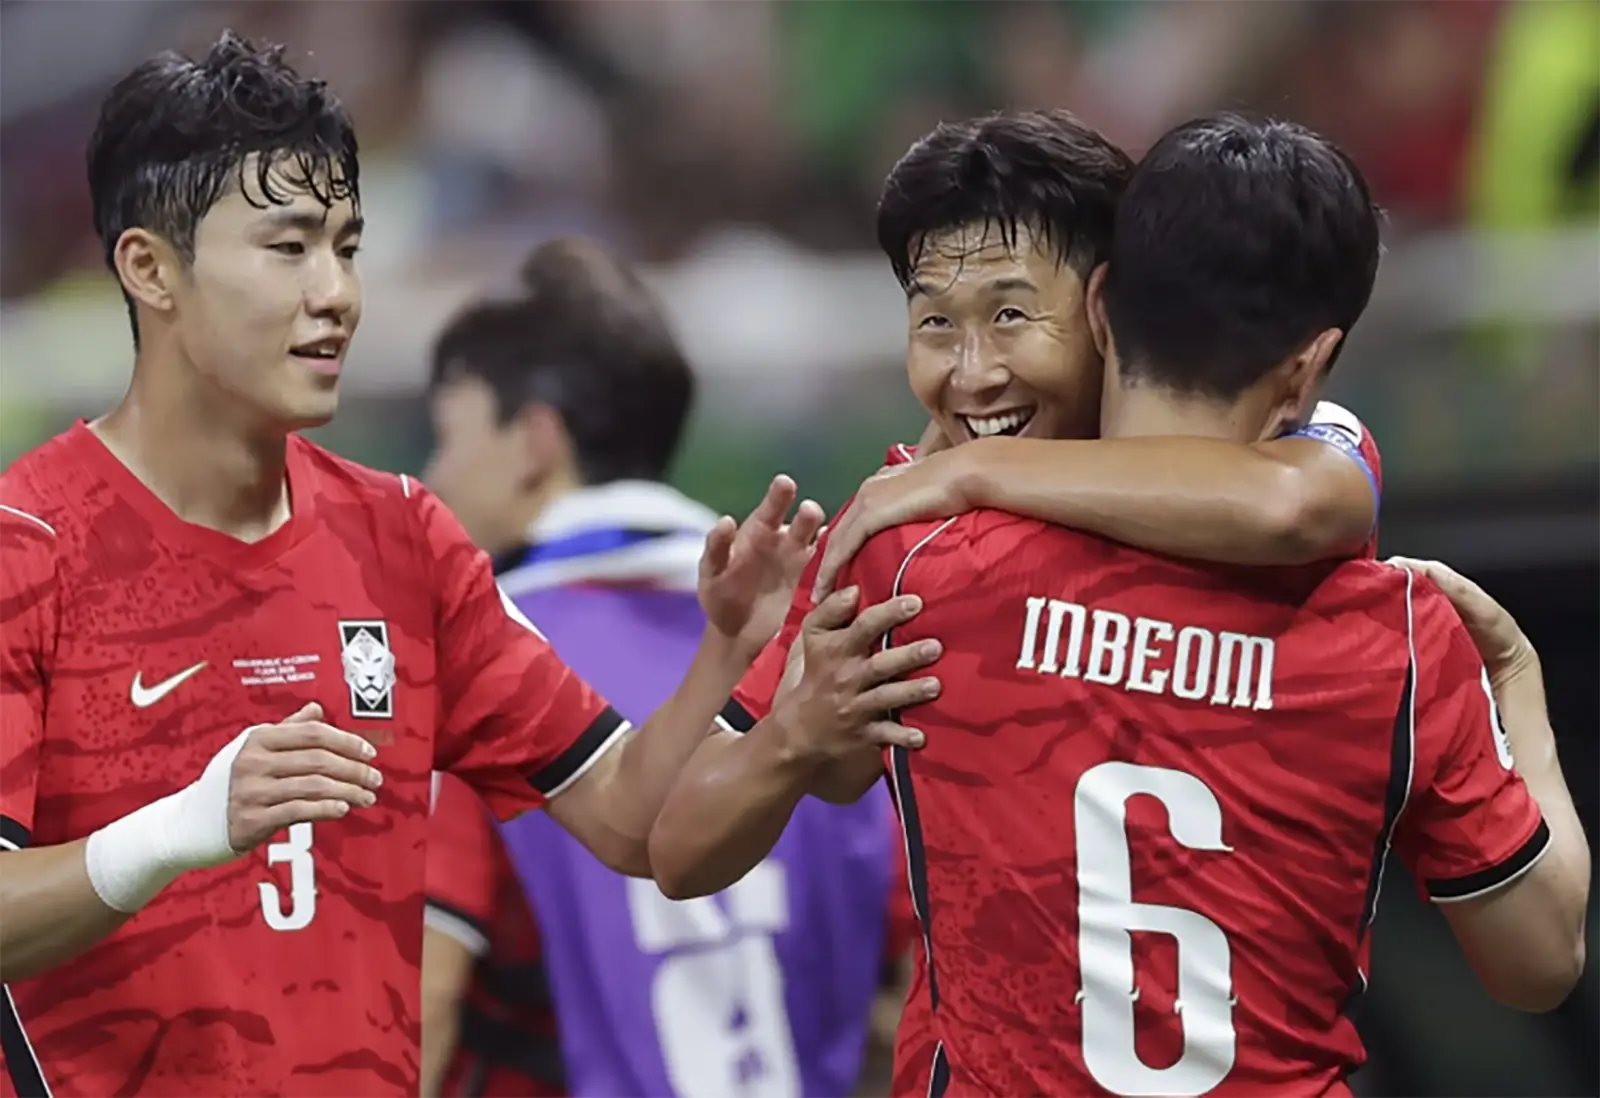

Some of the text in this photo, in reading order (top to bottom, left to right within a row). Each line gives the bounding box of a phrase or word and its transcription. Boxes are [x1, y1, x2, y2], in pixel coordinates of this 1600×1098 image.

[1016, 596, 1275, 710] INBEOM
[256, 820, 318, 931] 3
[1073, 760, 1238, 1097] 6
